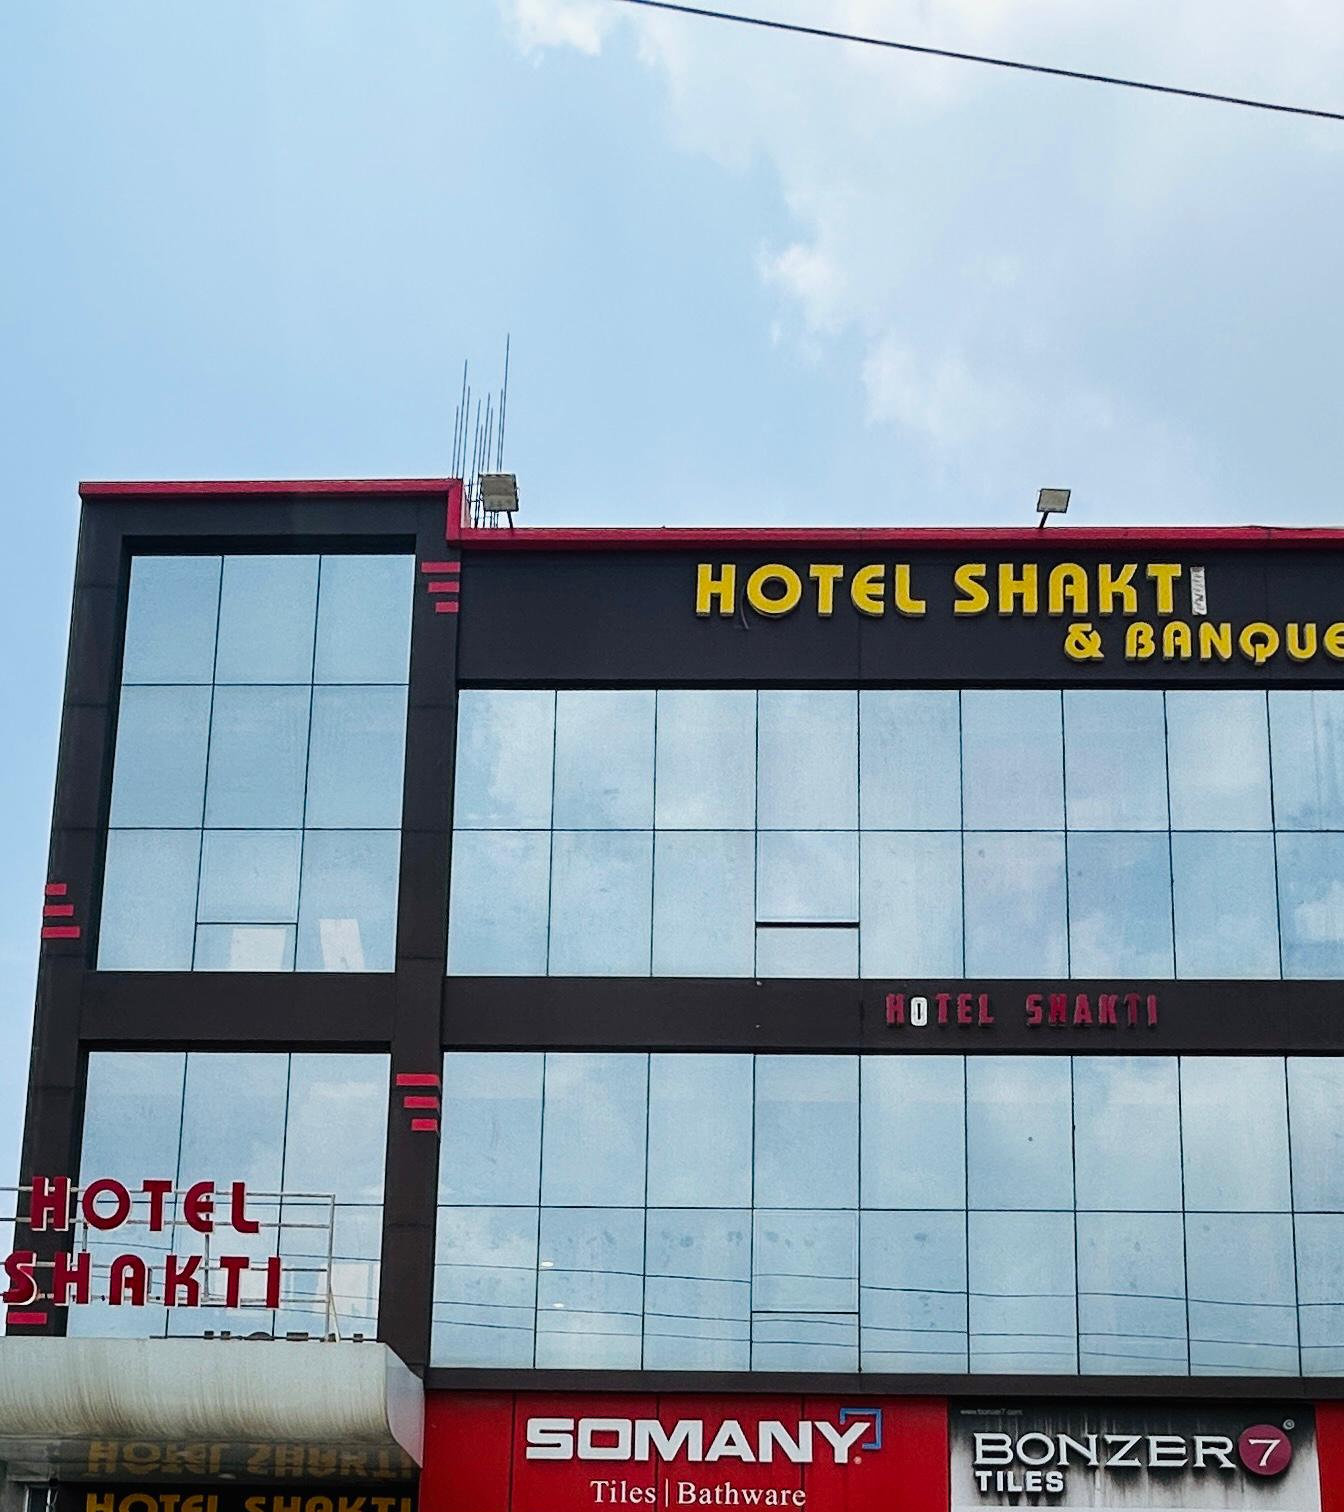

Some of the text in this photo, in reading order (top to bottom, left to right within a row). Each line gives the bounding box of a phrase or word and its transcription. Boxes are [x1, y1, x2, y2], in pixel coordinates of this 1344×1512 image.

[695, 562, 1209, 617] HOTEL SHAKTI
[1063, 623, 1104, 662] &
[884, 992, 1159, 1027] HOTEL SHAKTI
[30, 1174, 260, 1234] HOTEL
[2, 1250, 283, 1310] SHAKTI
[526, 1417, 871, 1464] SOMANY
[973, 1432, 1237, 1469] BONZER
[590, 1479, 806, 1507] Tiles Bathware
[976, 1471, 1064, 1493] TILES
